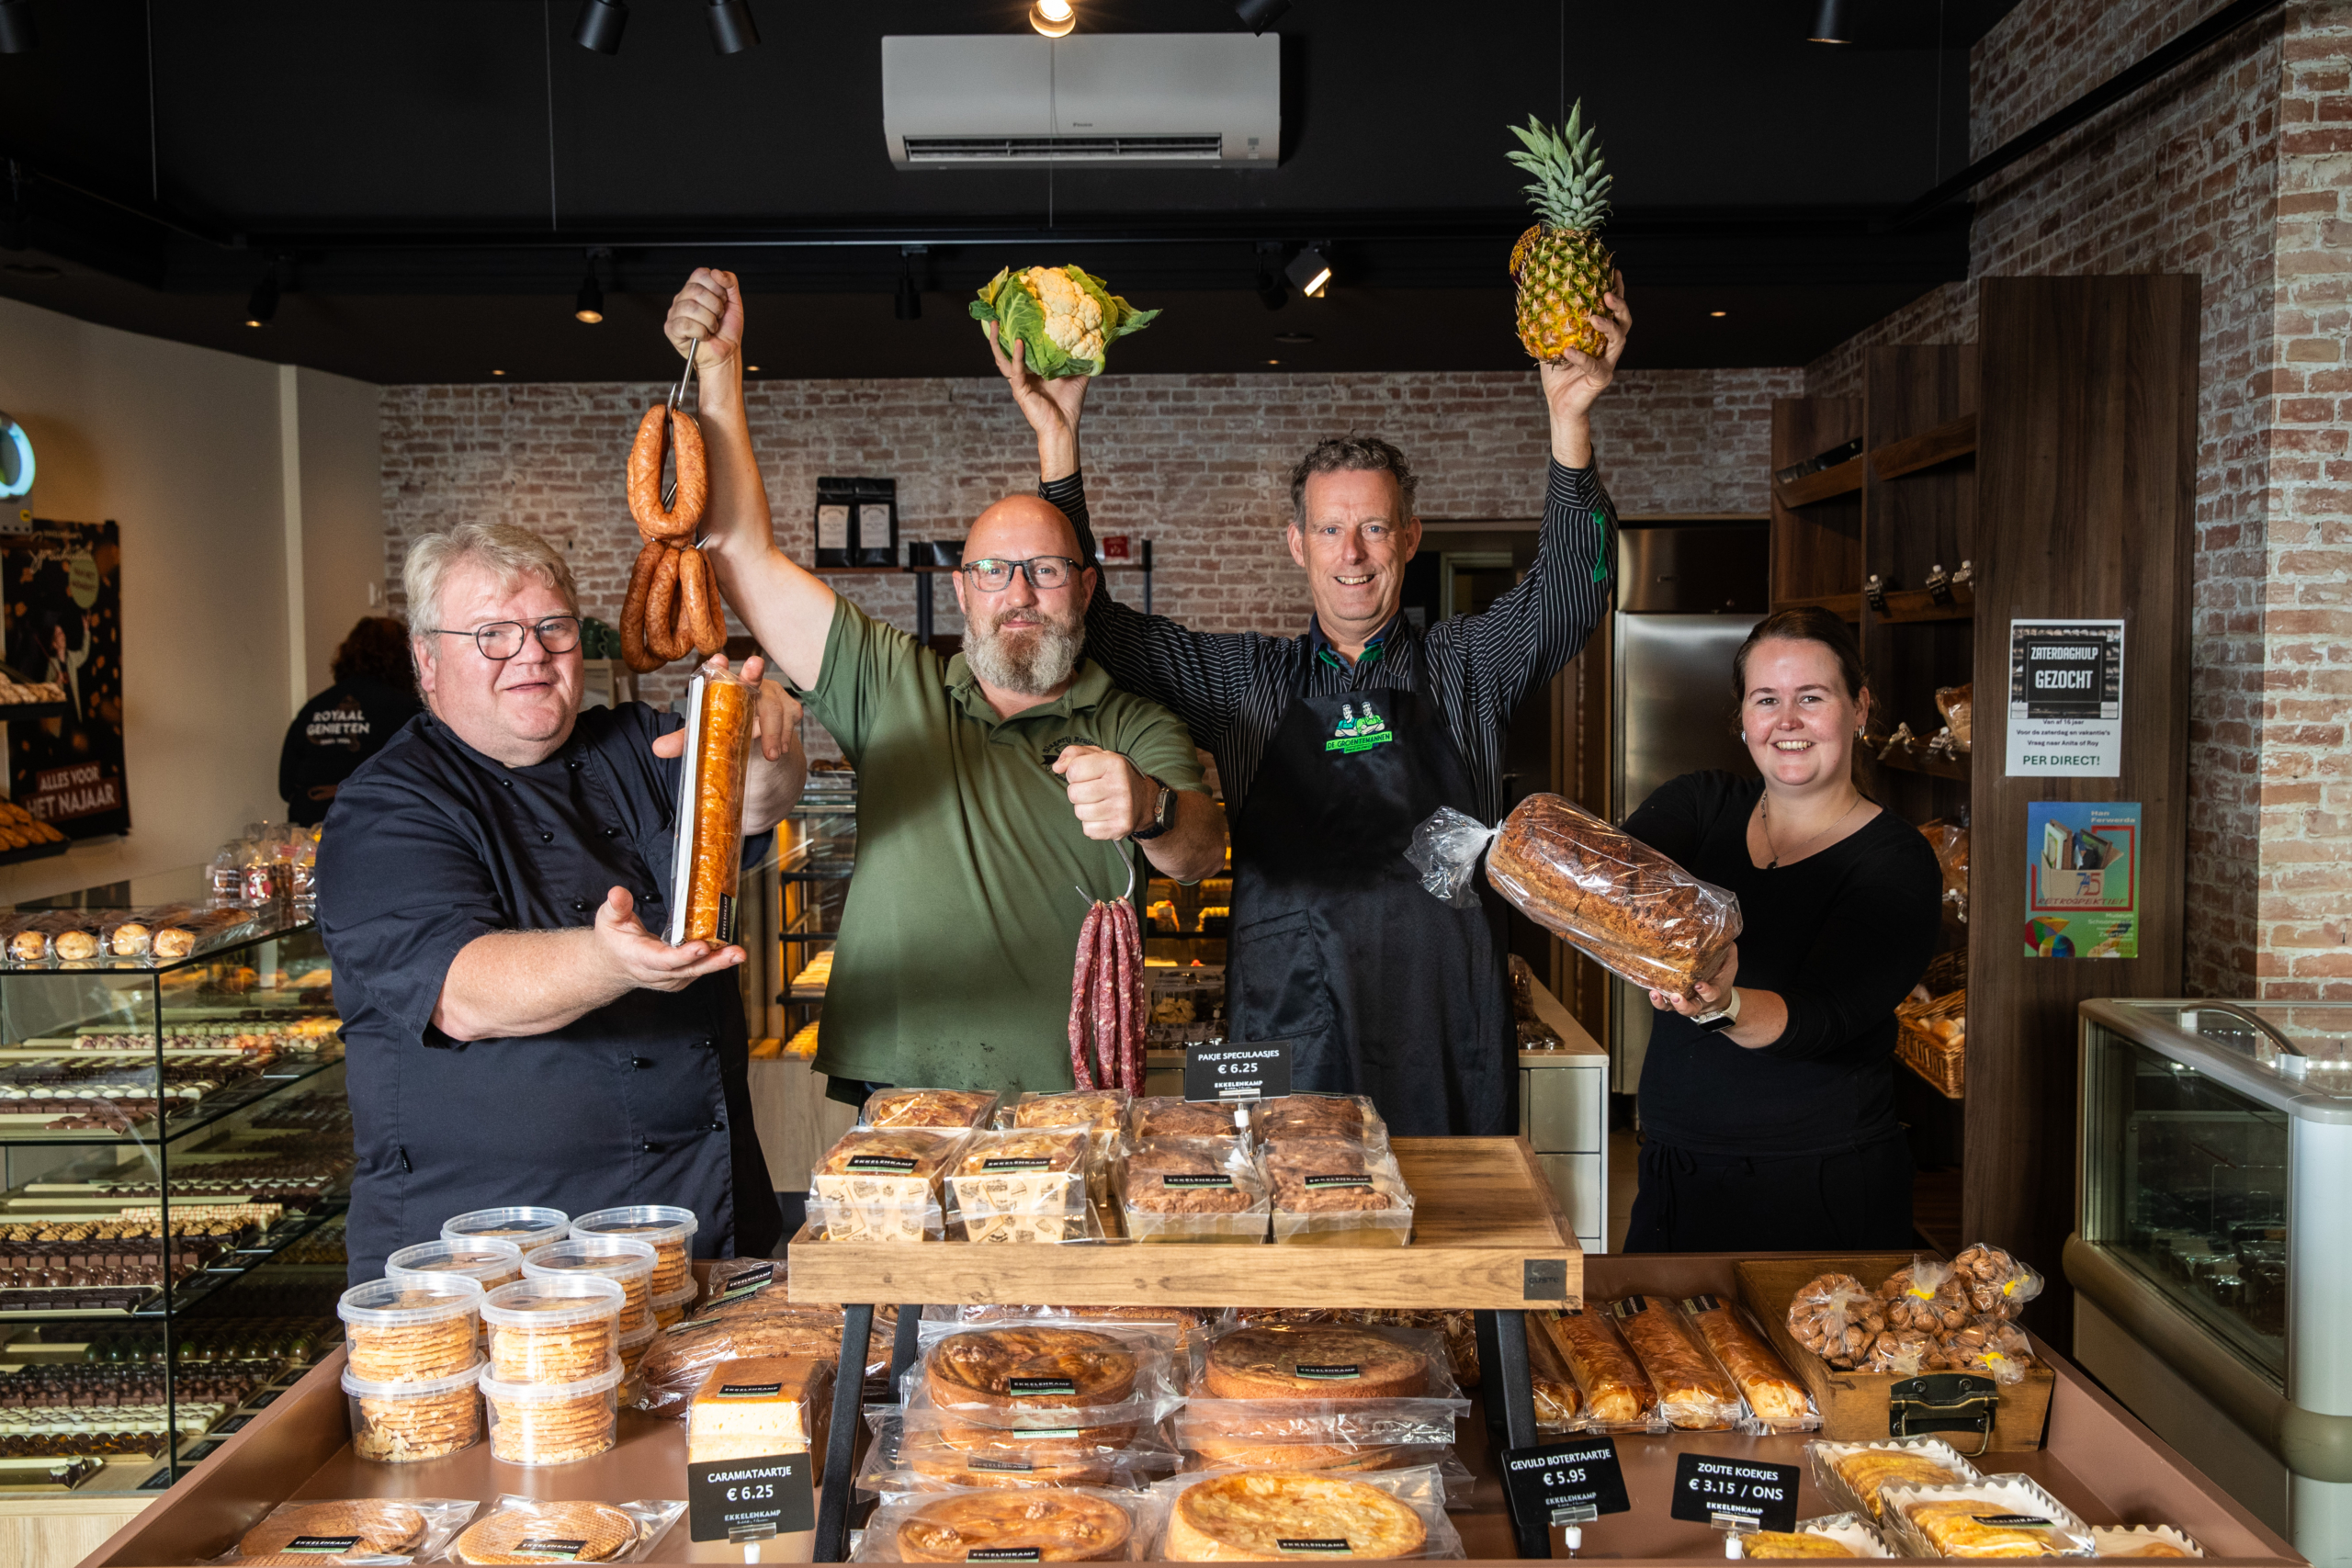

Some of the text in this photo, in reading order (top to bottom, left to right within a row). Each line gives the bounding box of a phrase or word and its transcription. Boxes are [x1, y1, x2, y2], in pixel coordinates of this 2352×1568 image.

[2030, 647, 2098, 660] ZATERDAGHULP
[2035, 670, 2093, 689] GEZOCHT
[313, 709, 366, 722] ROYAAL
[306, 722, 370, 736] GENIETEN
[1337, 733, 1390, 748] GROENTEMANNEN
[2023, 755, 2100, 765] PER DIRECT!
[40, 765, 100, 792] ALLES VOOR
[26, 783, 116, 819] HET NAJAAR
[1198, 1050, 1279, 1061] PAKJE SPECULAASJES
[1217, 1063, 1258, 1074] € 6.25
[1214, 1080, 1263, 1089] EKKELENKAMP
[729, 1270, 771, 1287] EKKELENKAMP
[1510, 1449, 1611, 1470] GEVULD BOTERTAARTJE
[707, 1466, 792, 1483] CARAMIATAARTJE
[1543, 1468, 1587, 1485] € 5.95
[1698, 1462, 1779, 1481] ZOUTE KOEKJES
[727, 1484, 774, 1501] € 6.25
[1689, 1478, 1783, 1500] € 3.15 / ONS
[1545, 1492, 1597, 1506] EKKELENKAMP
[724, 1509, 781, 1521] EKKELENKAMP
[1706, 1502, 1763, 1515] EKKELENKAMP
